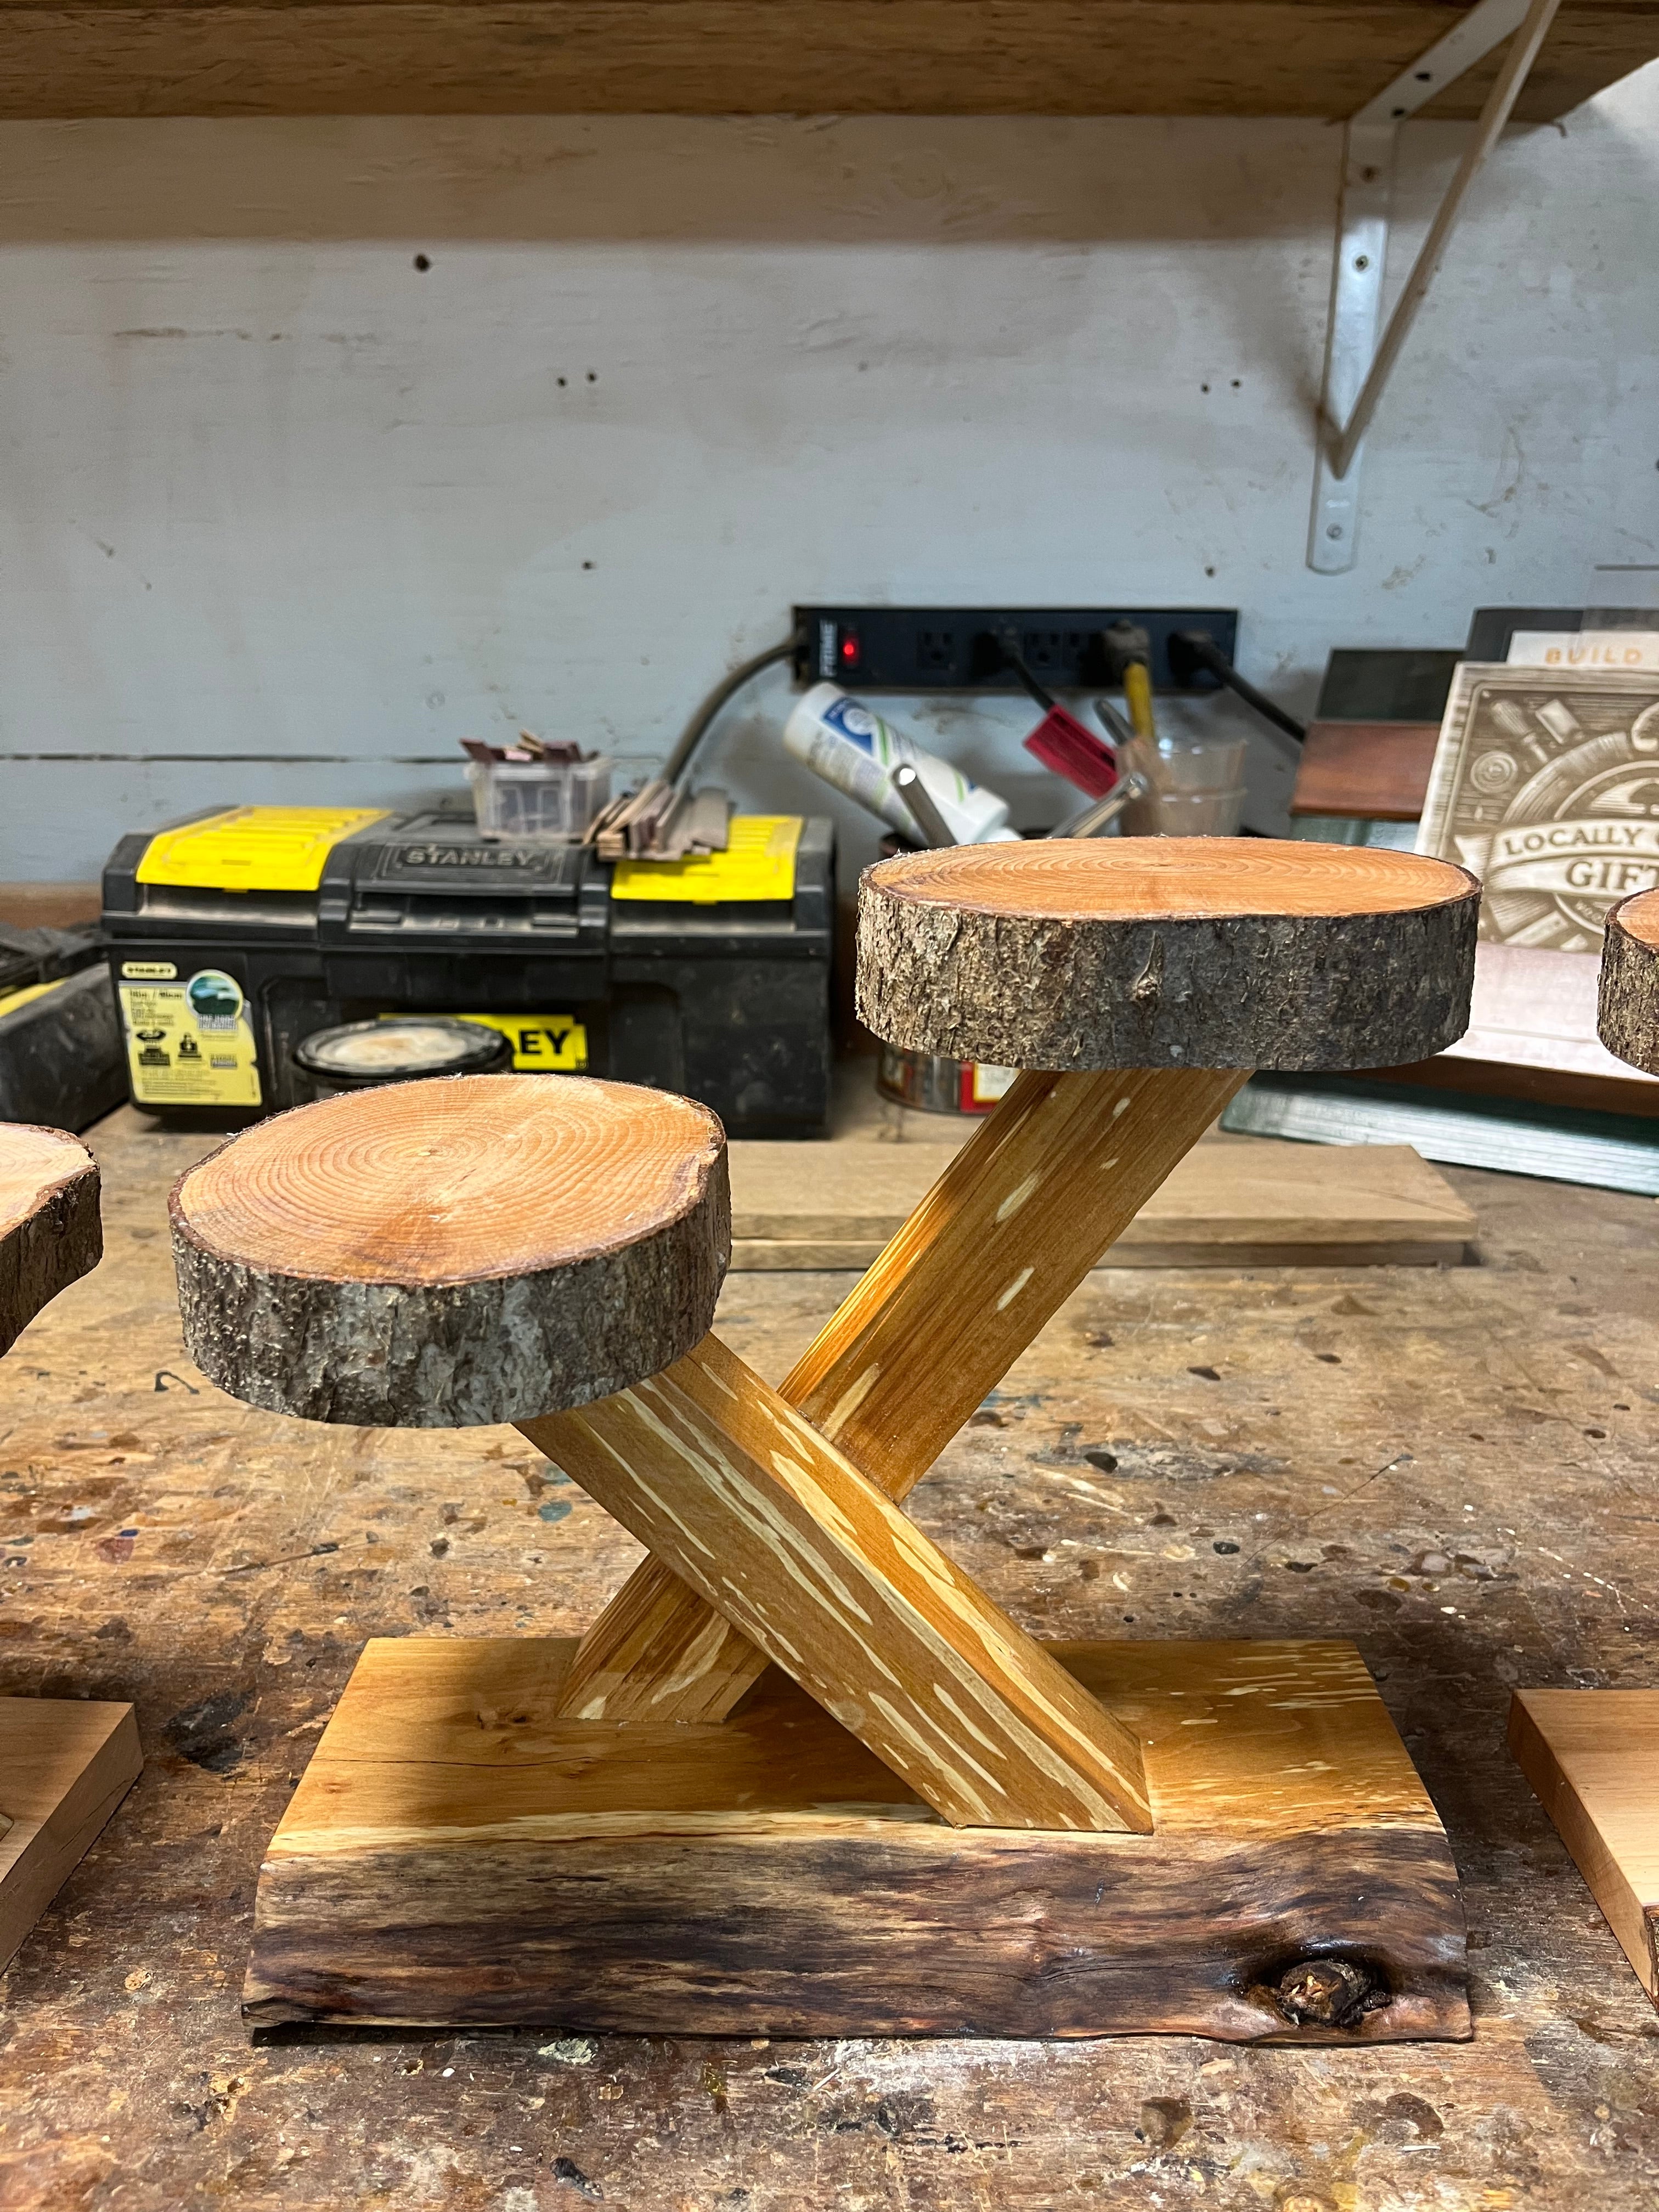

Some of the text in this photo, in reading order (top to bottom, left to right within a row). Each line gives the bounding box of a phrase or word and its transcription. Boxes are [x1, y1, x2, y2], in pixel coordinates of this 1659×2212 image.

[1545, 646, 1642, 664] BUILD
[1504, 826, 1644, 855] LOCALLY
[407, 845, 532, 866] STANLEY
